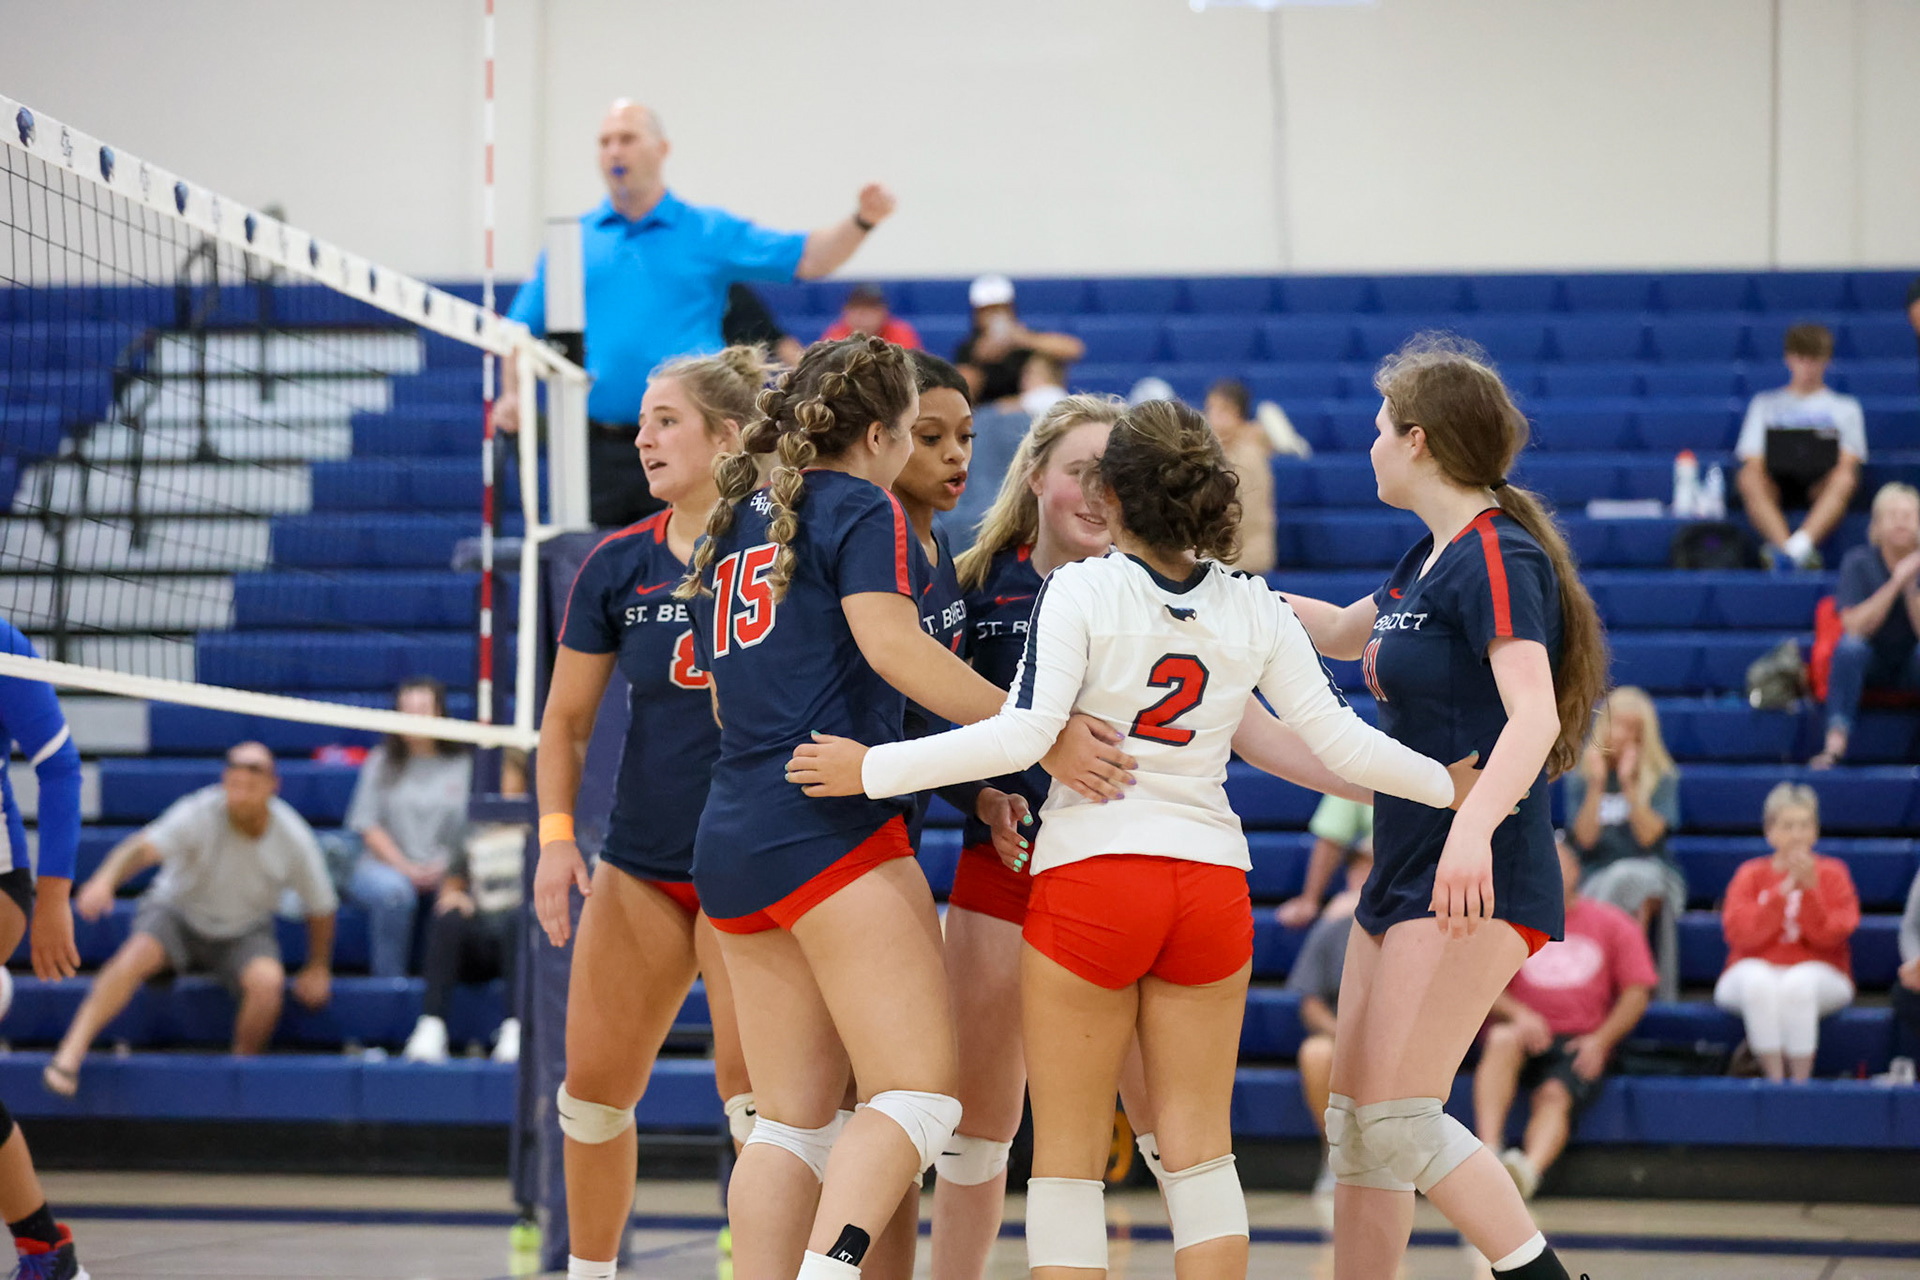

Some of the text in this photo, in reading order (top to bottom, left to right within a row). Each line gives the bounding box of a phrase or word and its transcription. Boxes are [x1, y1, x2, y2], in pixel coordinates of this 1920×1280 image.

[625, 605, 648, 626] ST.
[712, 542, 779, 659] 15
[976, 621, 1003, 640] ST.
[669, 628, 710, 690] 8
[1128, 653, 1210, 747] 2
[838, 1250, 853, 1263] KT
